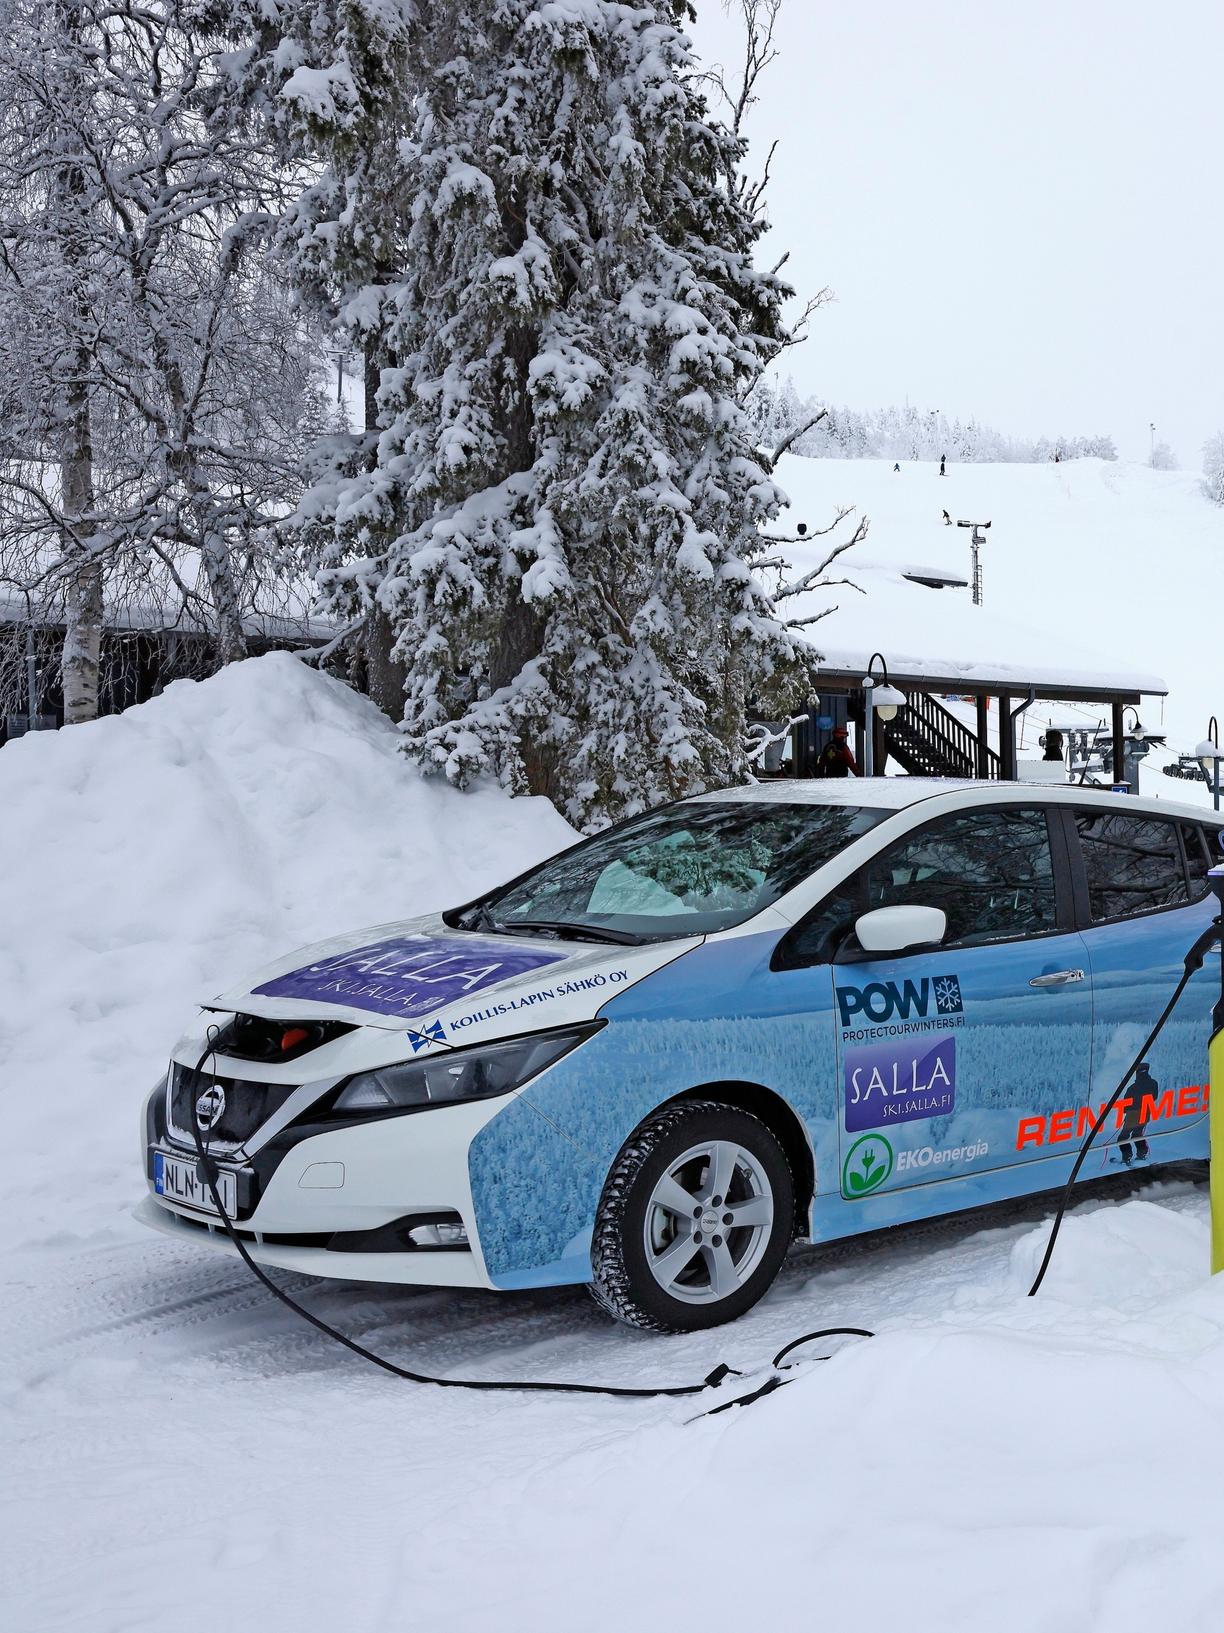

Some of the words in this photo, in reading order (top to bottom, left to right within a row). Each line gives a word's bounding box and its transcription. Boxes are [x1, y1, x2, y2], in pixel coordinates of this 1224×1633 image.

[309, 948, 503, 990] SALLA
[449, 989, 555, 1031] KOILLIS-LAPIN
[556, 973, 607, 996] SÄHKÖ
[609, 969, 629, 983] OY
[835, 977, 930, 1027] POW
[842, 1016, 966, 1042] PROTECTOURWINTERS.FI
[850, 1056, 951, 1104] SALLA
[883, 1094, 952, 1117] SKI.SALLA.FI
[1015, 1097, 1134, 1151] RENT
[1138, 1083, 1211, 1125] ME!
[896, 1139, 989, 1171] EKOenergia
